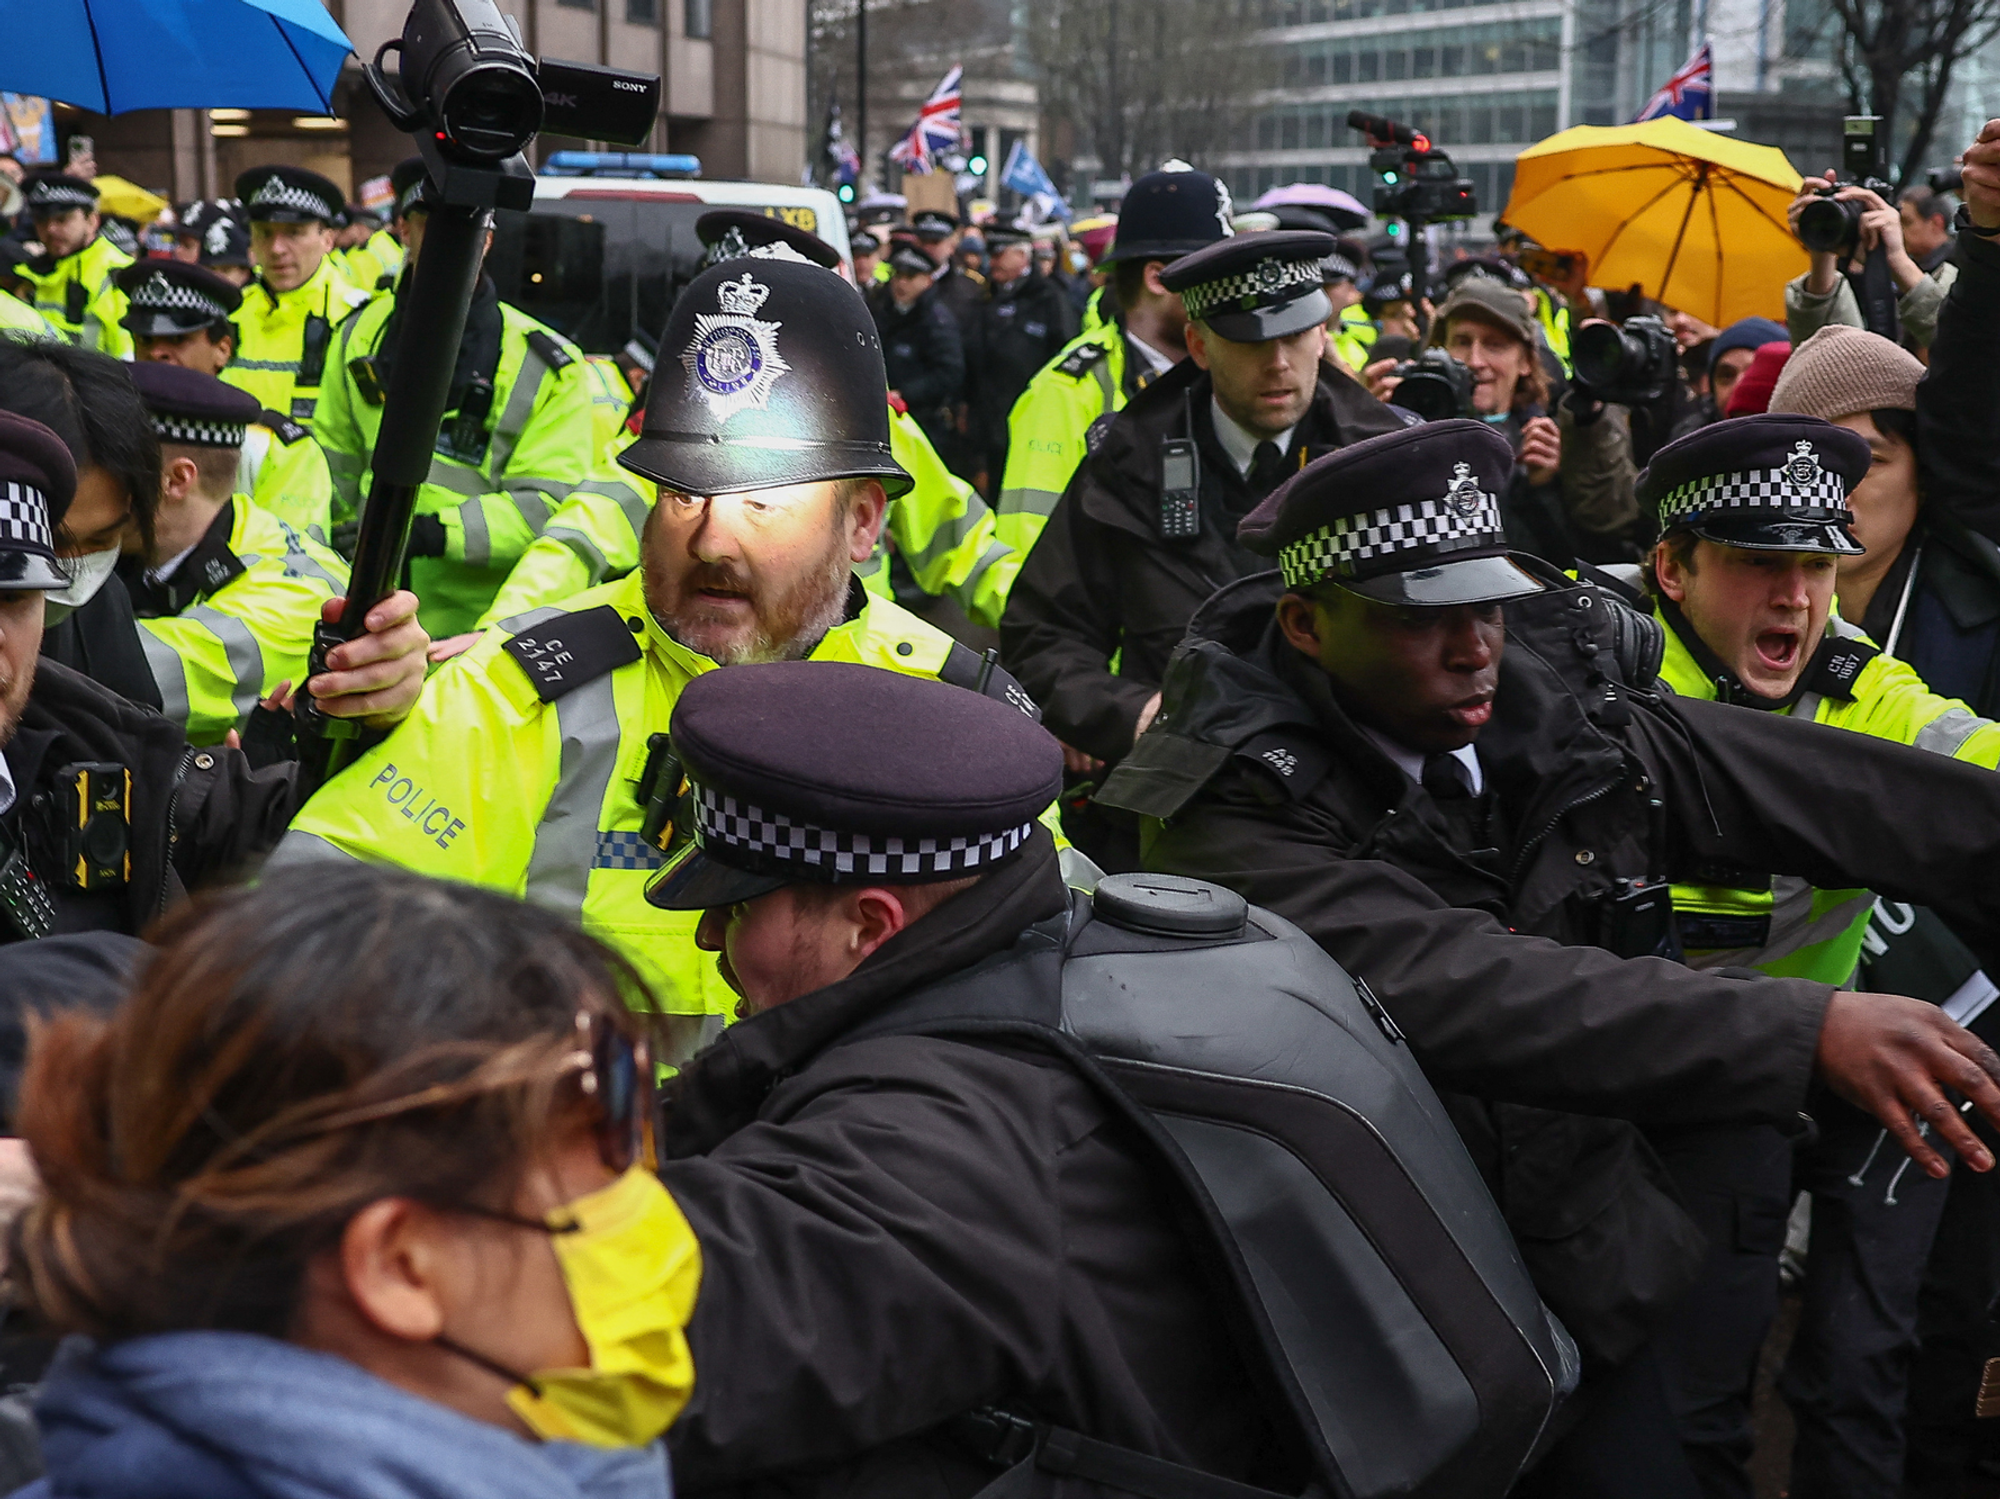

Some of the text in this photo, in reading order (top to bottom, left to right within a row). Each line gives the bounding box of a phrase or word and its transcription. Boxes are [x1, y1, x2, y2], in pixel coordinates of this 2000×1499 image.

[542, 92, 577, 108] 4K
[612, 80, 647, 94] SONY
[517, 638, 564, 682] 2147
[545, 639, 574, 666] CE
[1827, 654, 1845, 673] CN
[1837, 653, 1860, 680] 1667
[369, 763, 466, 850] POLICE
